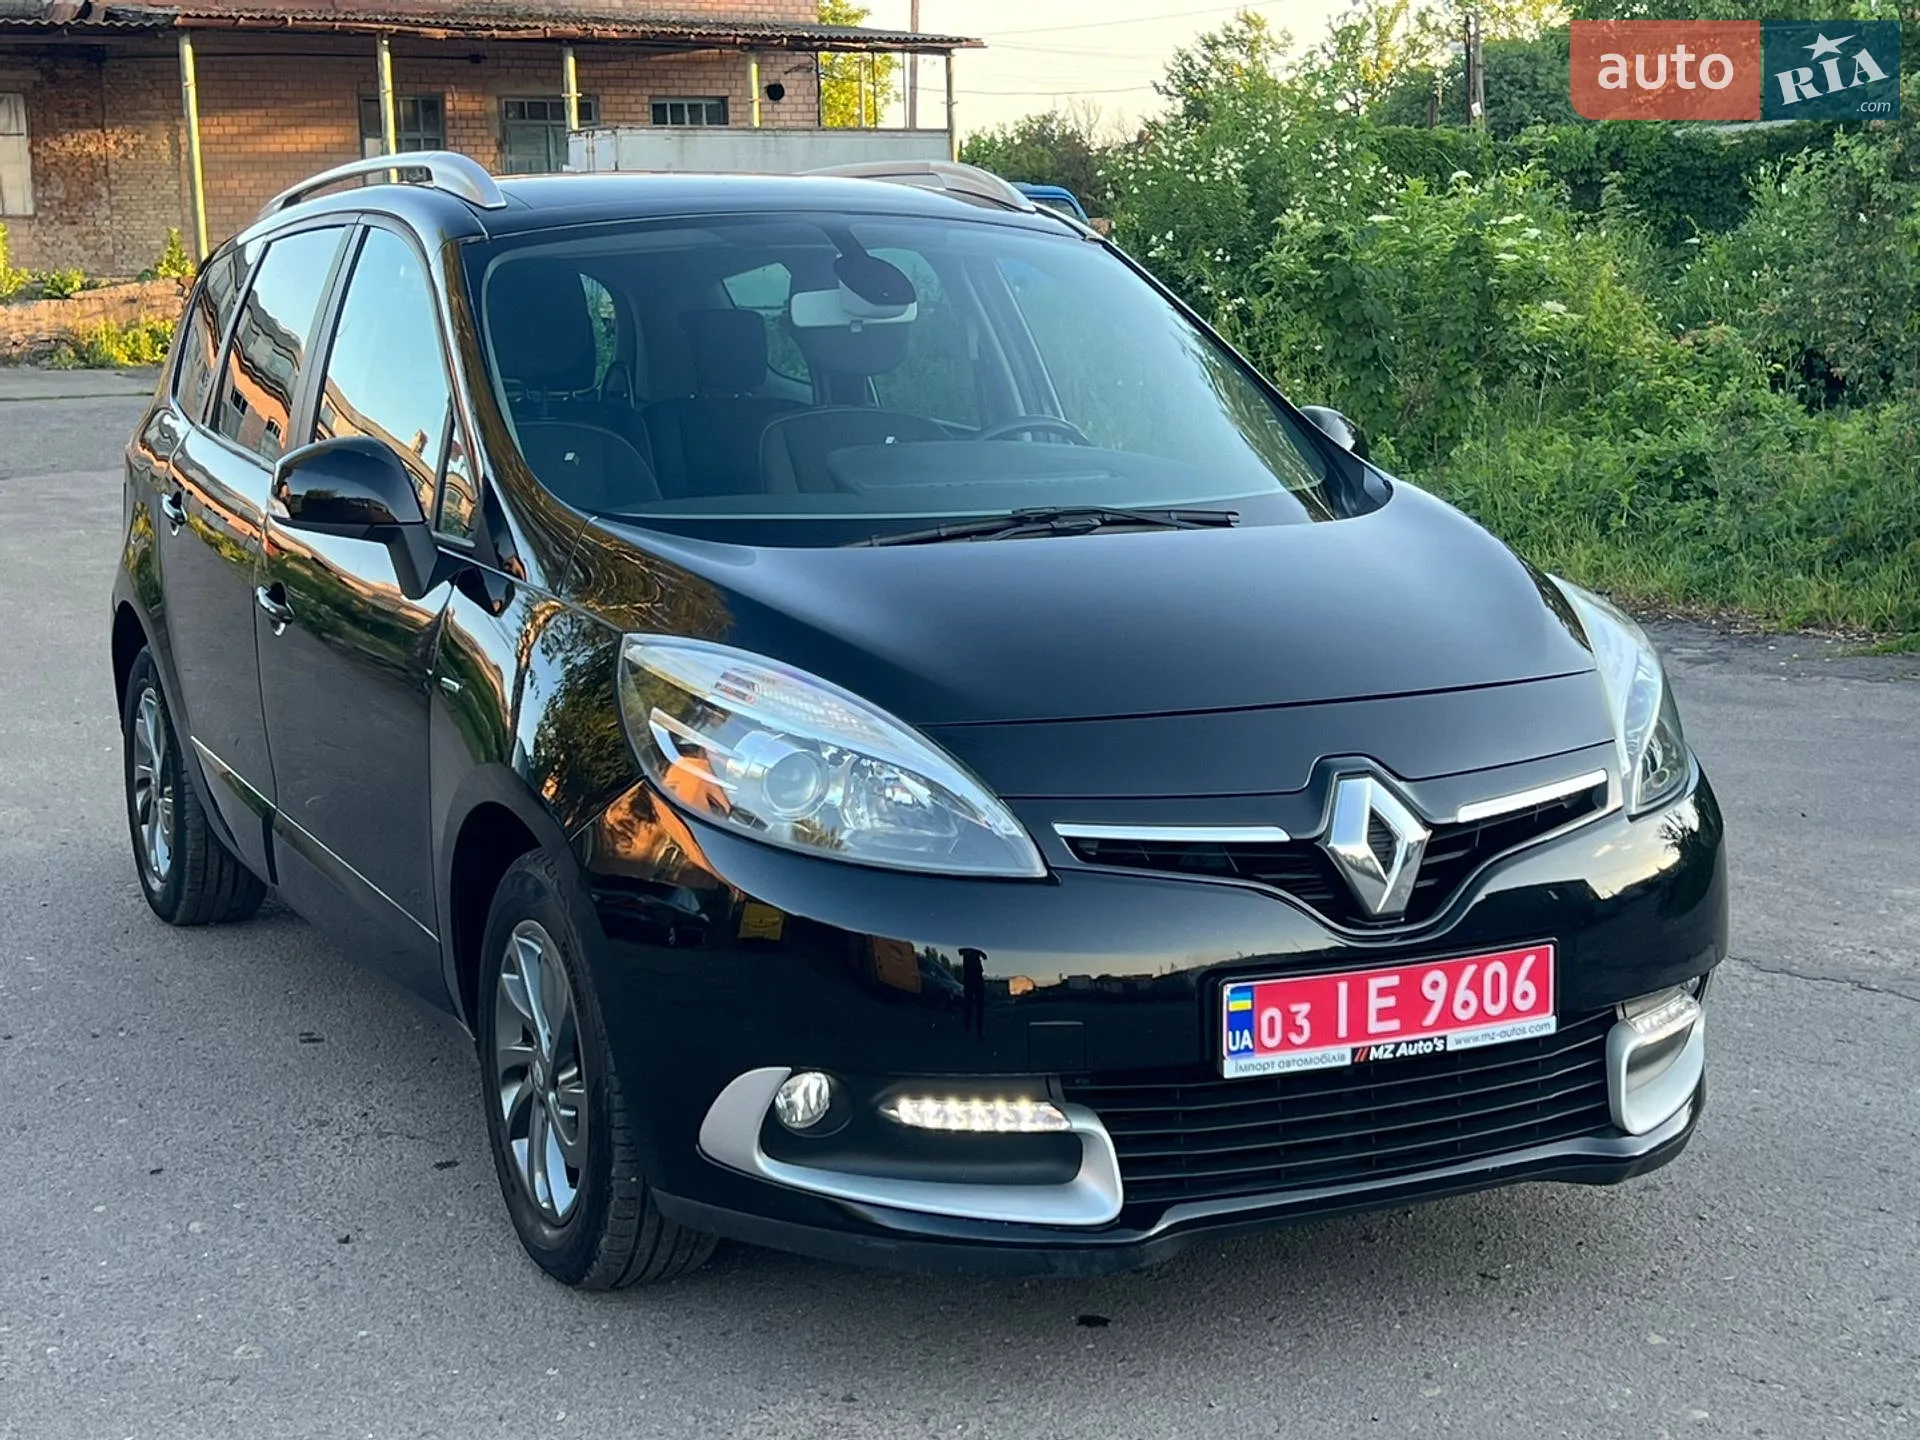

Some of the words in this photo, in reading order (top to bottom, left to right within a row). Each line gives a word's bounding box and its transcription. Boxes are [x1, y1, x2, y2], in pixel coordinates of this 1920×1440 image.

[1260, 1003, 1312, 1049] 03
[1337, 974, 1401, 1039] IE
[1420, 954, 1537, 1028] 9606
[1228, 1029, 1254, 1051] UA
[1454, 1022, 1551, 1046] www.mz-autos.com
